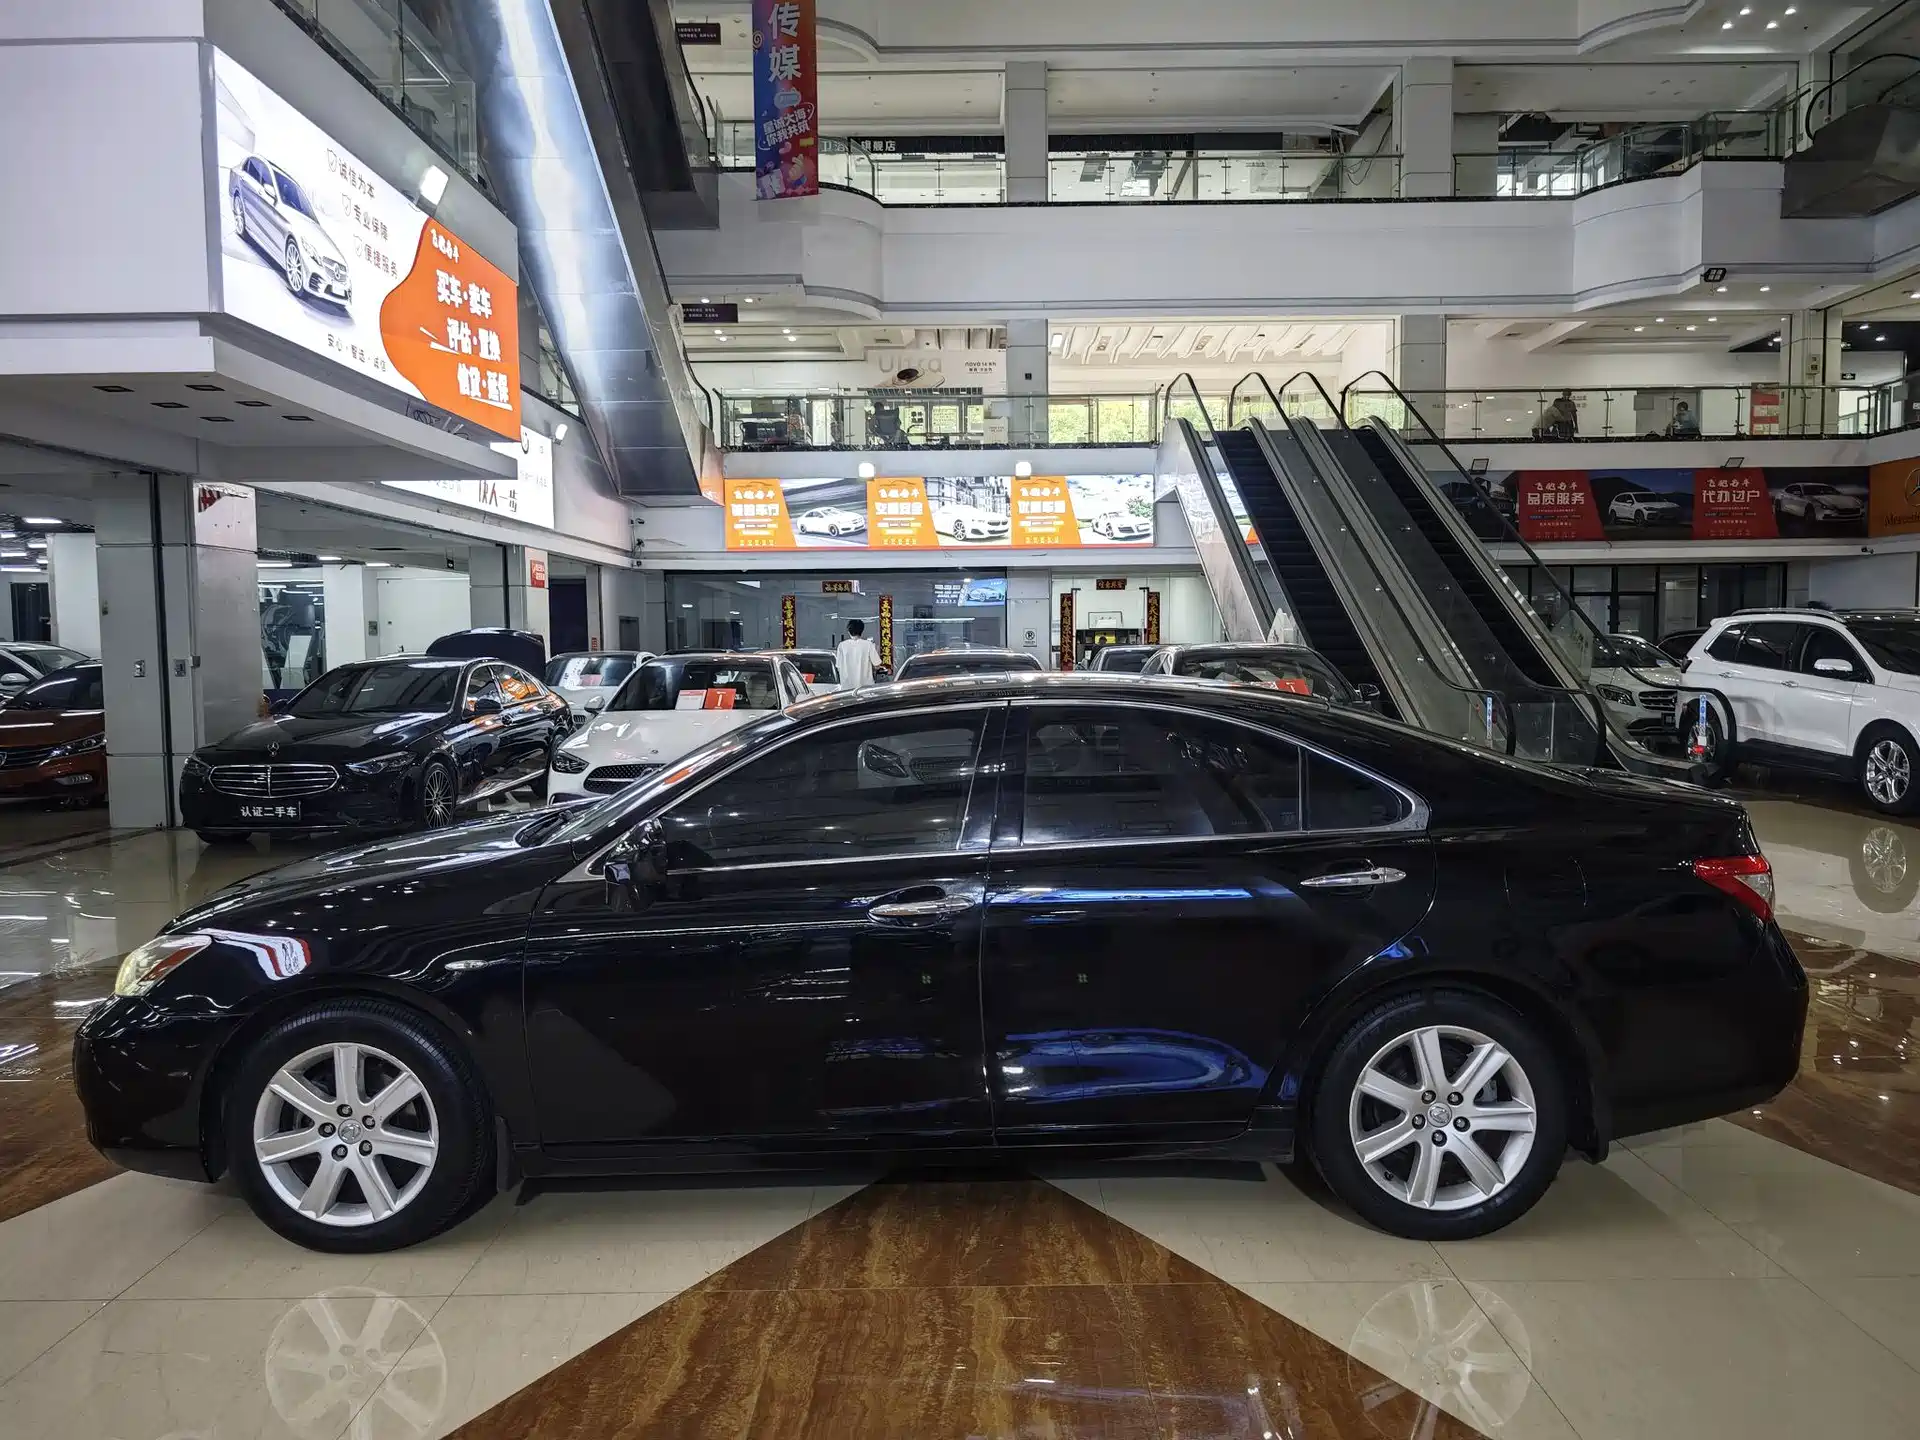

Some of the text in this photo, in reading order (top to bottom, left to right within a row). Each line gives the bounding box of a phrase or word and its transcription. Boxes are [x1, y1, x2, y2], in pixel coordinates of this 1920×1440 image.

[768, 2, 802, 82] 传媒
[861, 140, 896, 152] 旗舰店
[1527, 492, 1585, 505] 品质服务
[1702, 490, 1760, 503] 代办过户
[240, 806, 297, 818] 认证二手车
